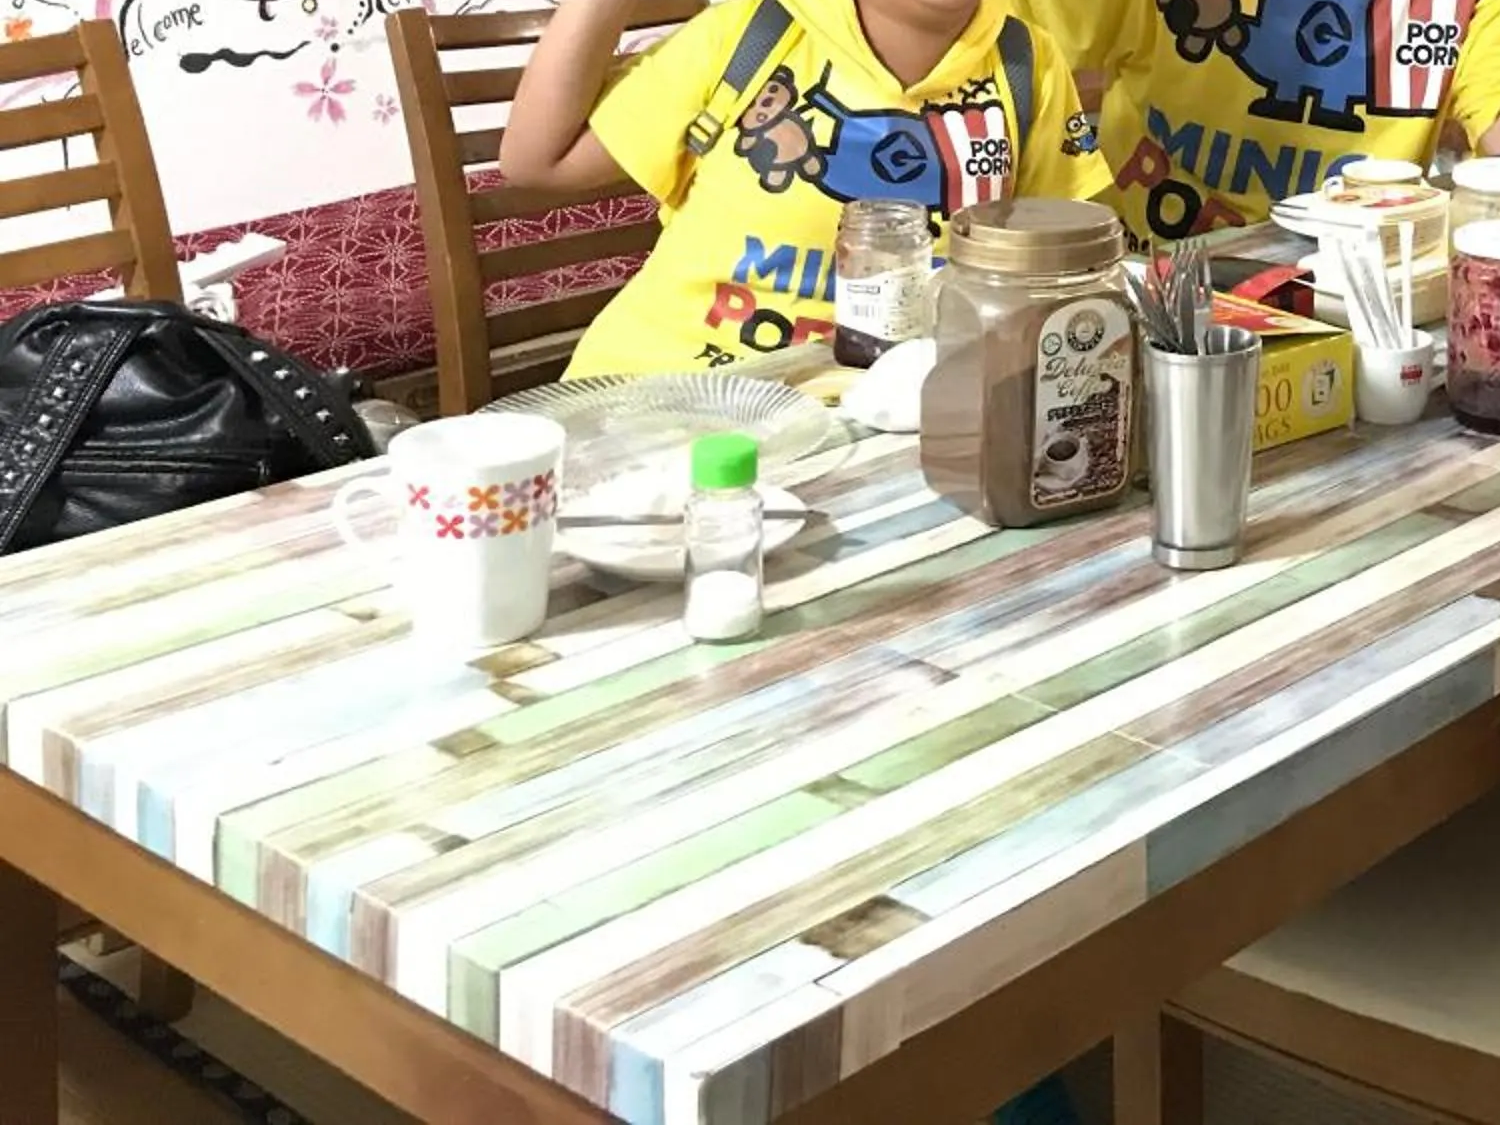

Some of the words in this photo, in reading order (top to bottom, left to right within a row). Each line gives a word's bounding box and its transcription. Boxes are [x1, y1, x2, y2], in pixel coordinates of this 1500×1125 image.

[1406, 22, 1459, 44] POP
[1395, 43, 1460, 67] CORN
[970, 137, 1010, 159] POP
[965, 156, 1013, 177] CORN
